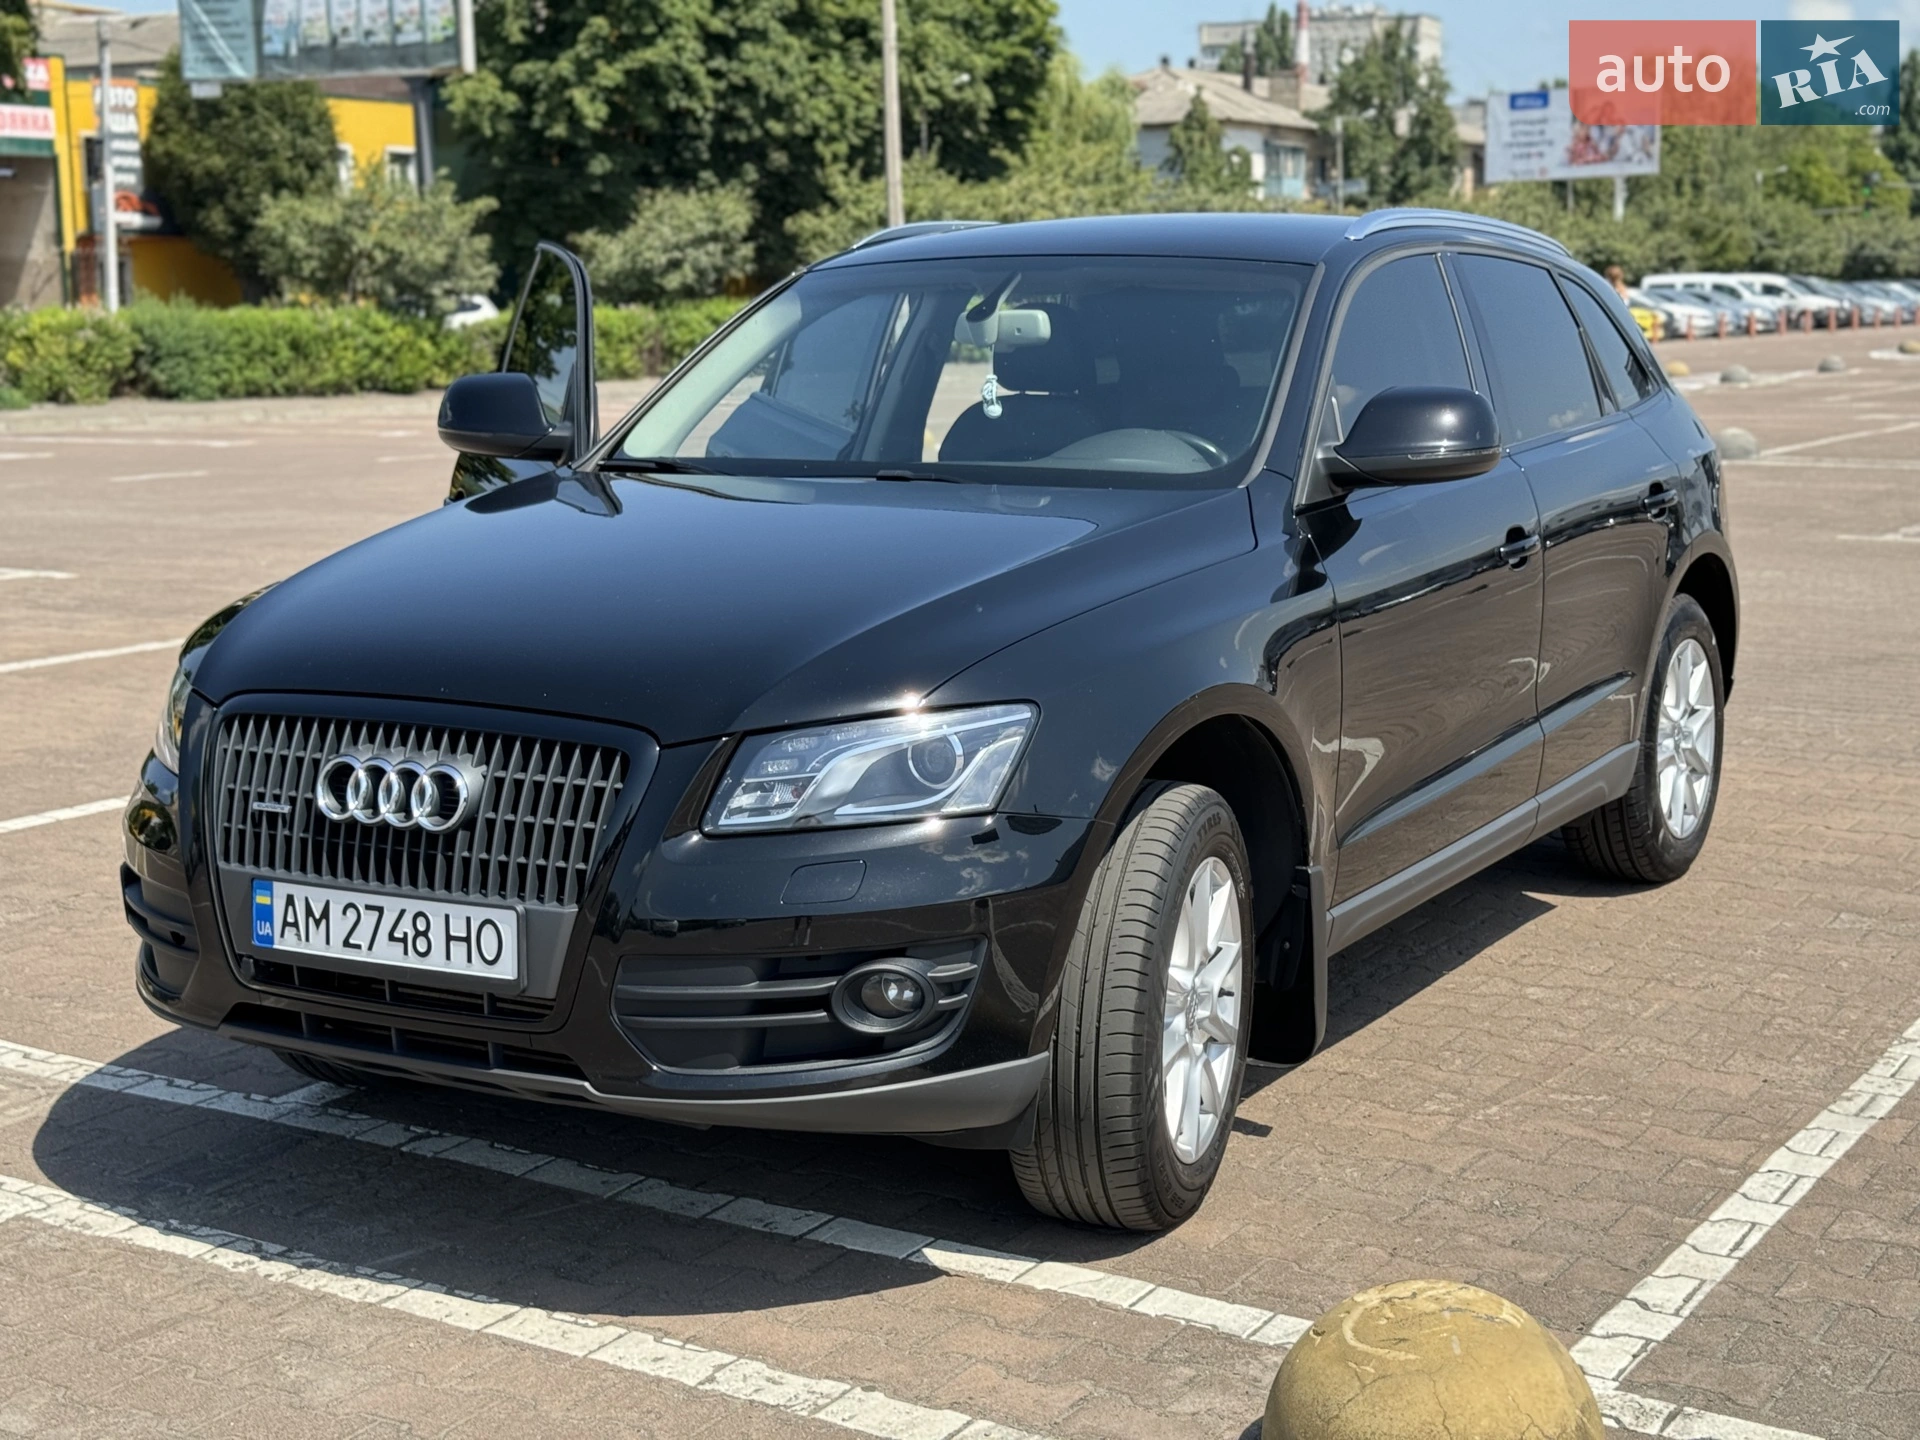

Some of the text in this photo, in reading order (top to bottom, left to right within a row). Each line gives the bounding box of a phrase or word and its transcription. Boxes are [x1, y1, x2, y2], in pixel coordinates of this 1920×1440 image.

[256, 920, 273, 937] UA
[279, 893, 504, 967] AM 2748 HO
